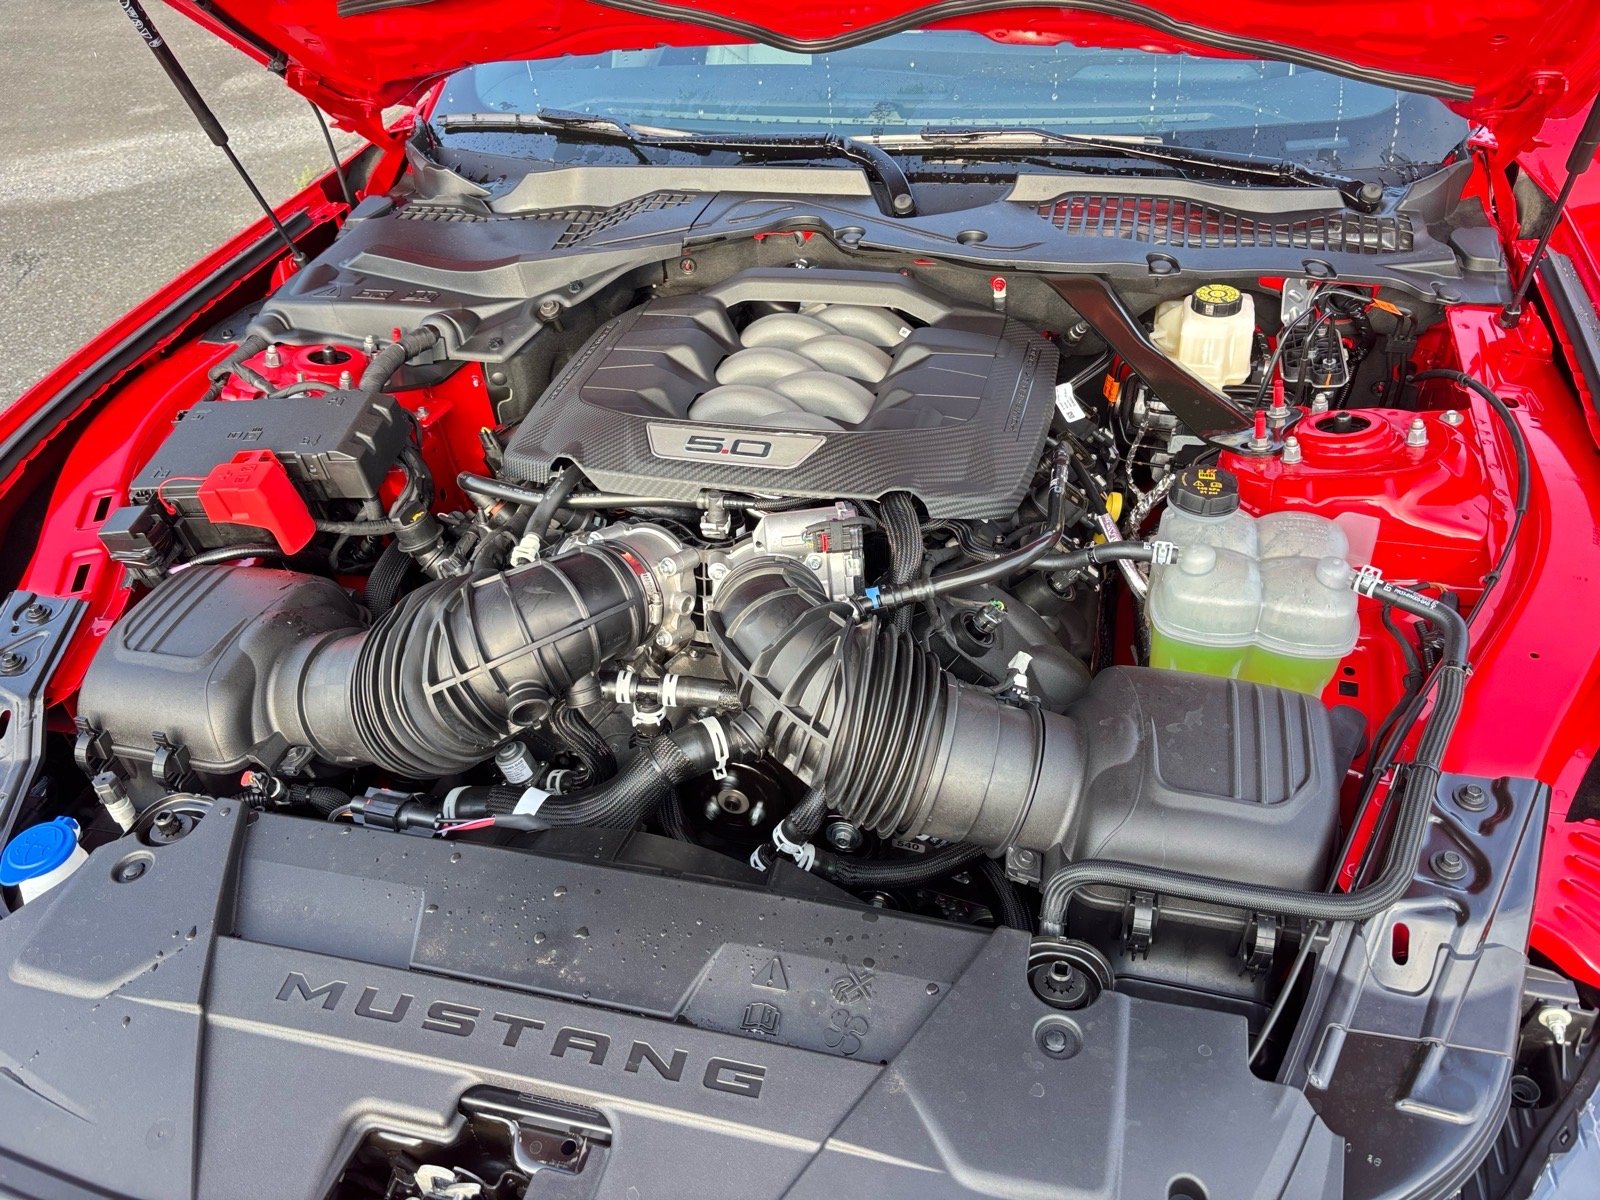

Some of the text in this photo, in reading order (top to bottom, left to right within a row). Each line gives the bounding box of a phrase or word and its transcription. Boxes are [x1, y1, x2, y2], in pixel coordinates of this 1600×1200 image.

[684, 435, 772, 458] 5.0
[897, 840, 920, 850] 540
[275, 971, 768, 1099] MUSTANG
